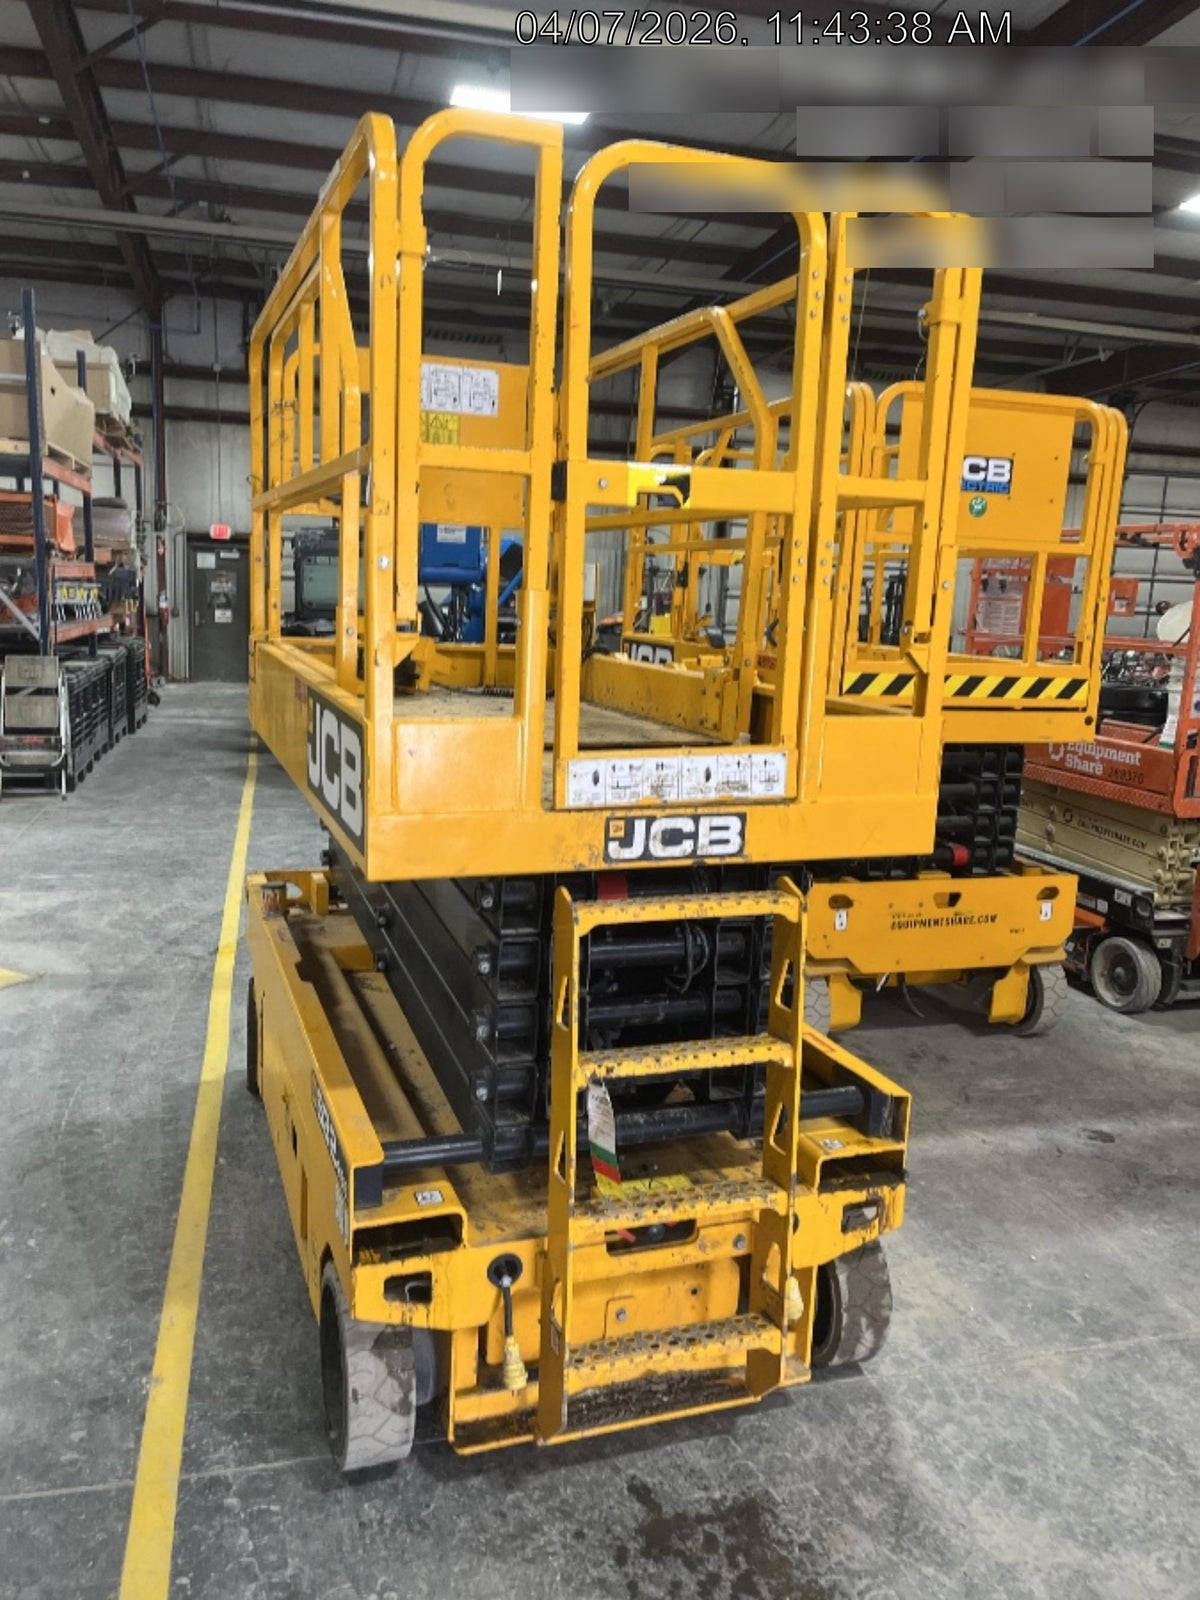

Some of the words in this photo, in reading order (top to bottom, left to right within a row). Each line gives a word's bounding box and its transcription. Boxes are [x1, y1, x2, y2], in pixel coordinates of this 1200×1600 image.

[963, 456, 1011, 483] CB
[1064, 753, 1104, 776] Share
[1066, 741, 1142, 766] Equipment
[308, 701, 363, 837] JCB
[607, 814, 743, 860] JCB
